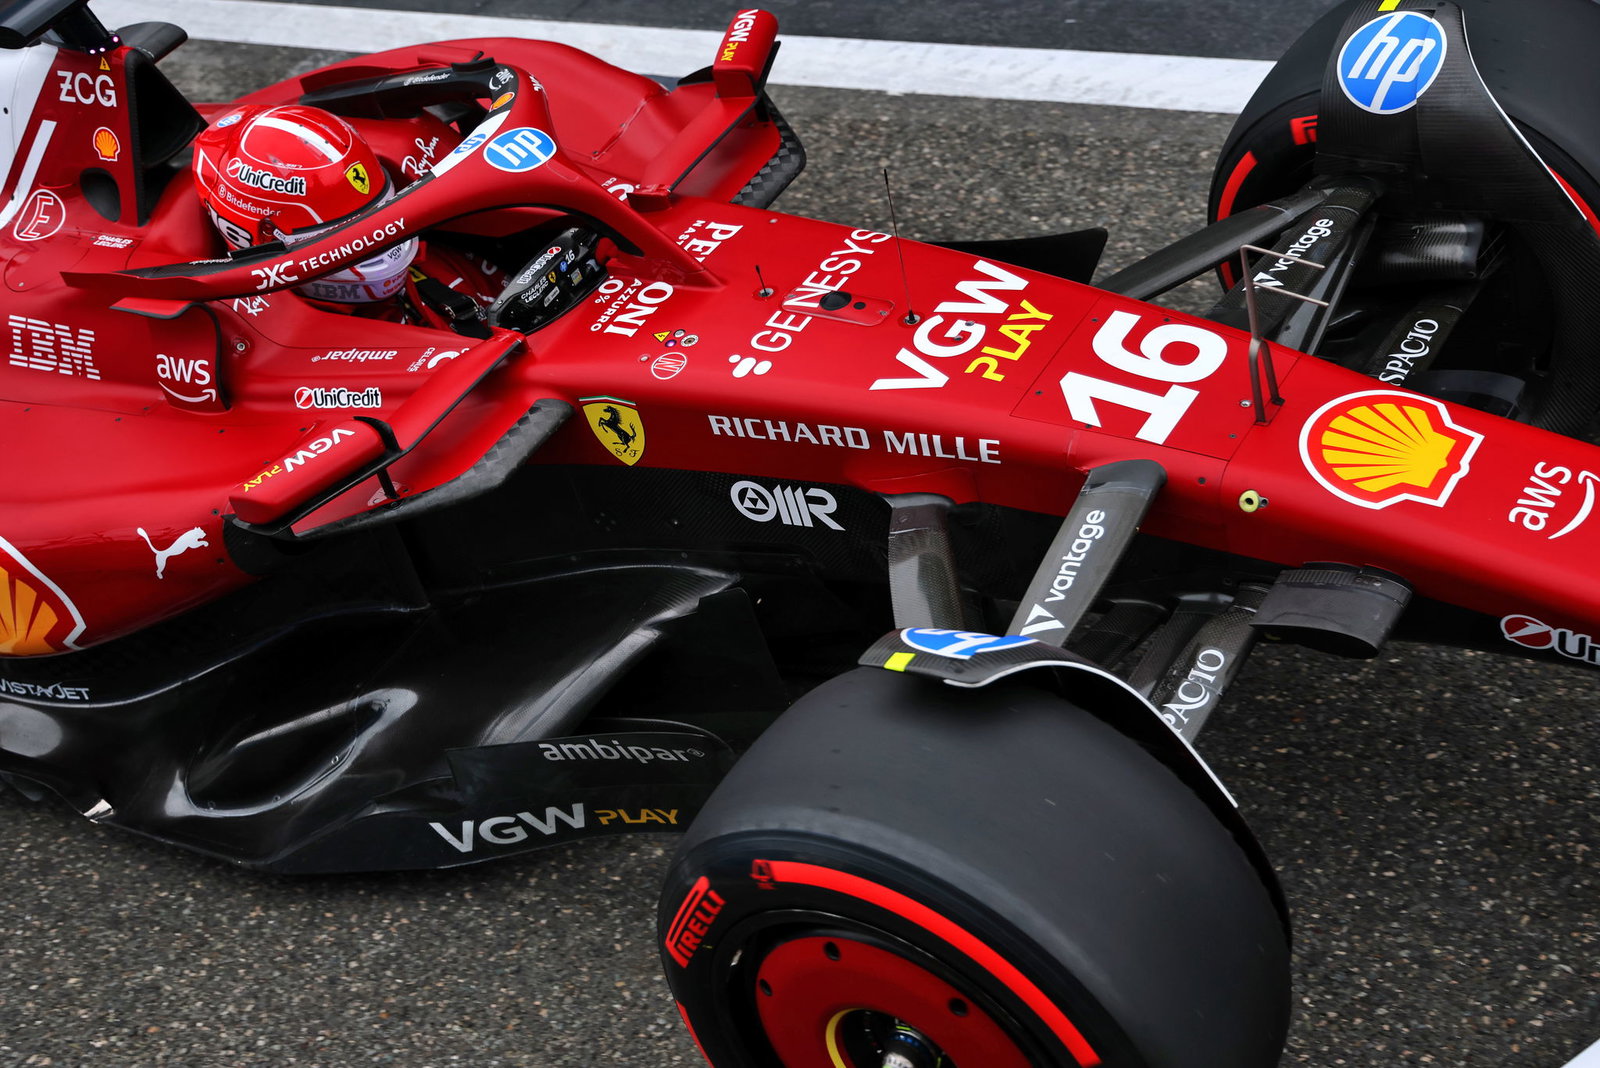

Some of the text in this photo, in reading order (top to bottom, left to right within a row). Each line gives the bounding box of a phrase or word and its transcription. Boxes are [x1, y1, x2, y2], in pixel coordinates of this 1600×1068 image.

[728, 9, 759, 42] VGW
[57, 71, 117, 107] ZCG
[1348, 13, 1436, 111] hp
[239, 164, 305, 195] UniCredit
[492, 131, 549, 167] hp
[20, 195, 53, 238] E
[1269, 218, 1333, 272] vantage
[251, 217, 406, 290] DXC TECHNOLOGY
[590, 277, 643, 332] AZZURRO
[750, 229, 892, 352] GENESYS
[8, 314, 101, 381] IBM
[869, 259, 1030, 391] VGW
[964, 299, 1054, 382] PLAY
[1379, 319, 1439, 387] SPACIO
[156, 354, 211, 385] aws
[313, 388, 381, 407] UniCredit
[1059, 310, 1228, 446] 16
[243, 428, 355, 492] VGW PLAY
[707, 414, 1001, 464] RICHARD MILLE
[1508, 461, 1572, 531] aws
[1044, 509, 1105, 603] vantage
[429, 803, 678, 853] VGW PLAY
[665, 875, 727, 968] PIRELLI
